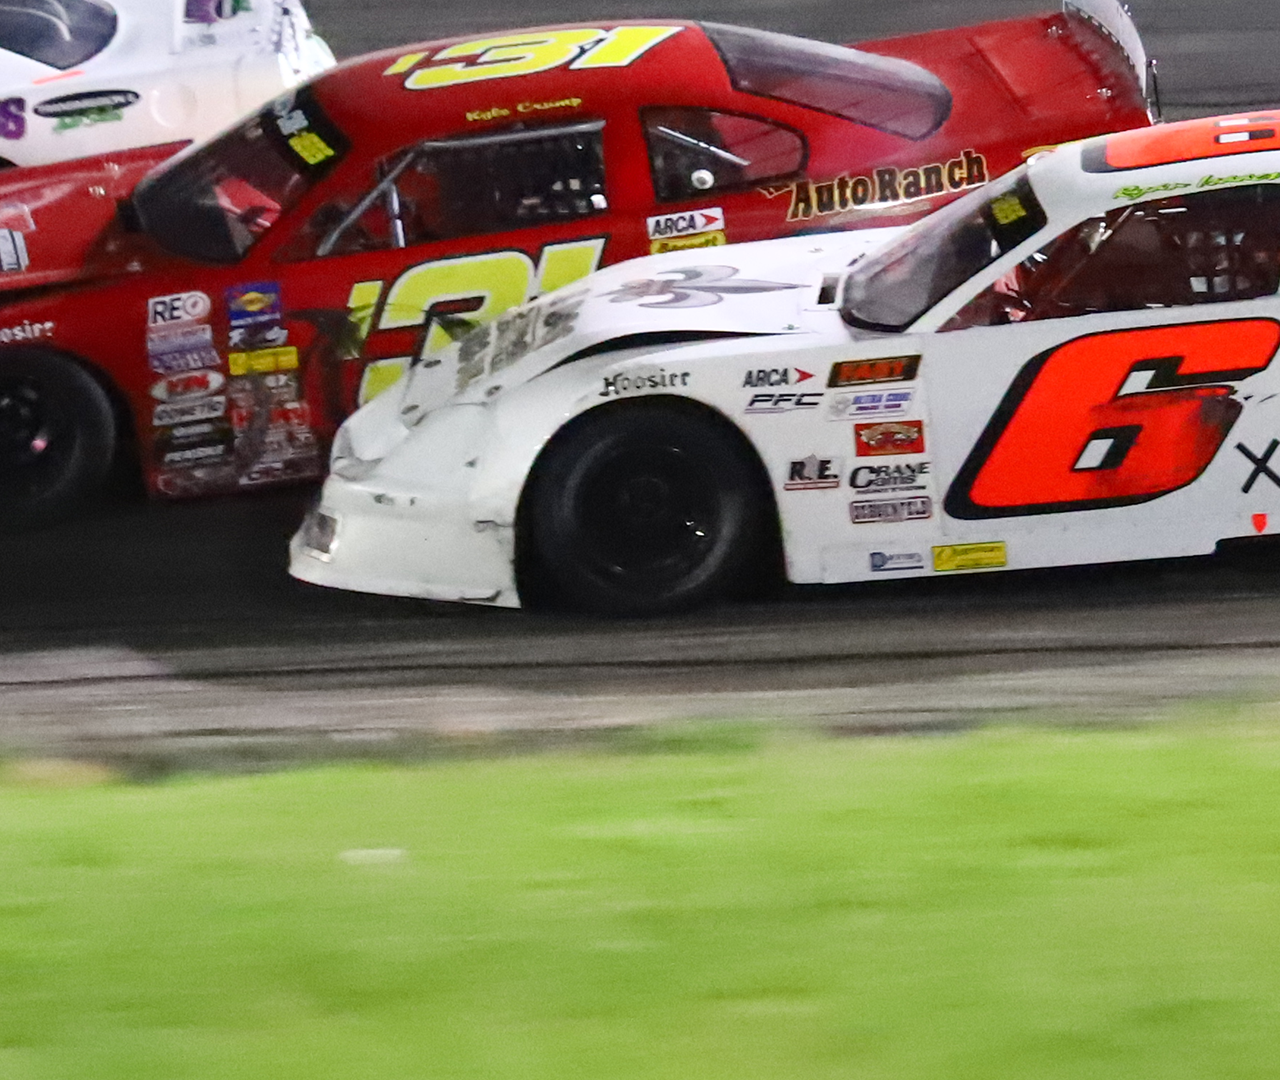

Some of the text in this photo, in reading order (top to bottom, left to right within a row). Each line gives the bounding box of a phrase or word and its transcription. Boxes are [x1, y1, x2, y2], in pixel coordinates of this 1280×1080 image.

[651, 213, 697, 237] ARCA
[597, 369, 692, 397] Hoosier
[742, 367, 790, 388] ARCA
[747, 392, 825, 407] PFC
